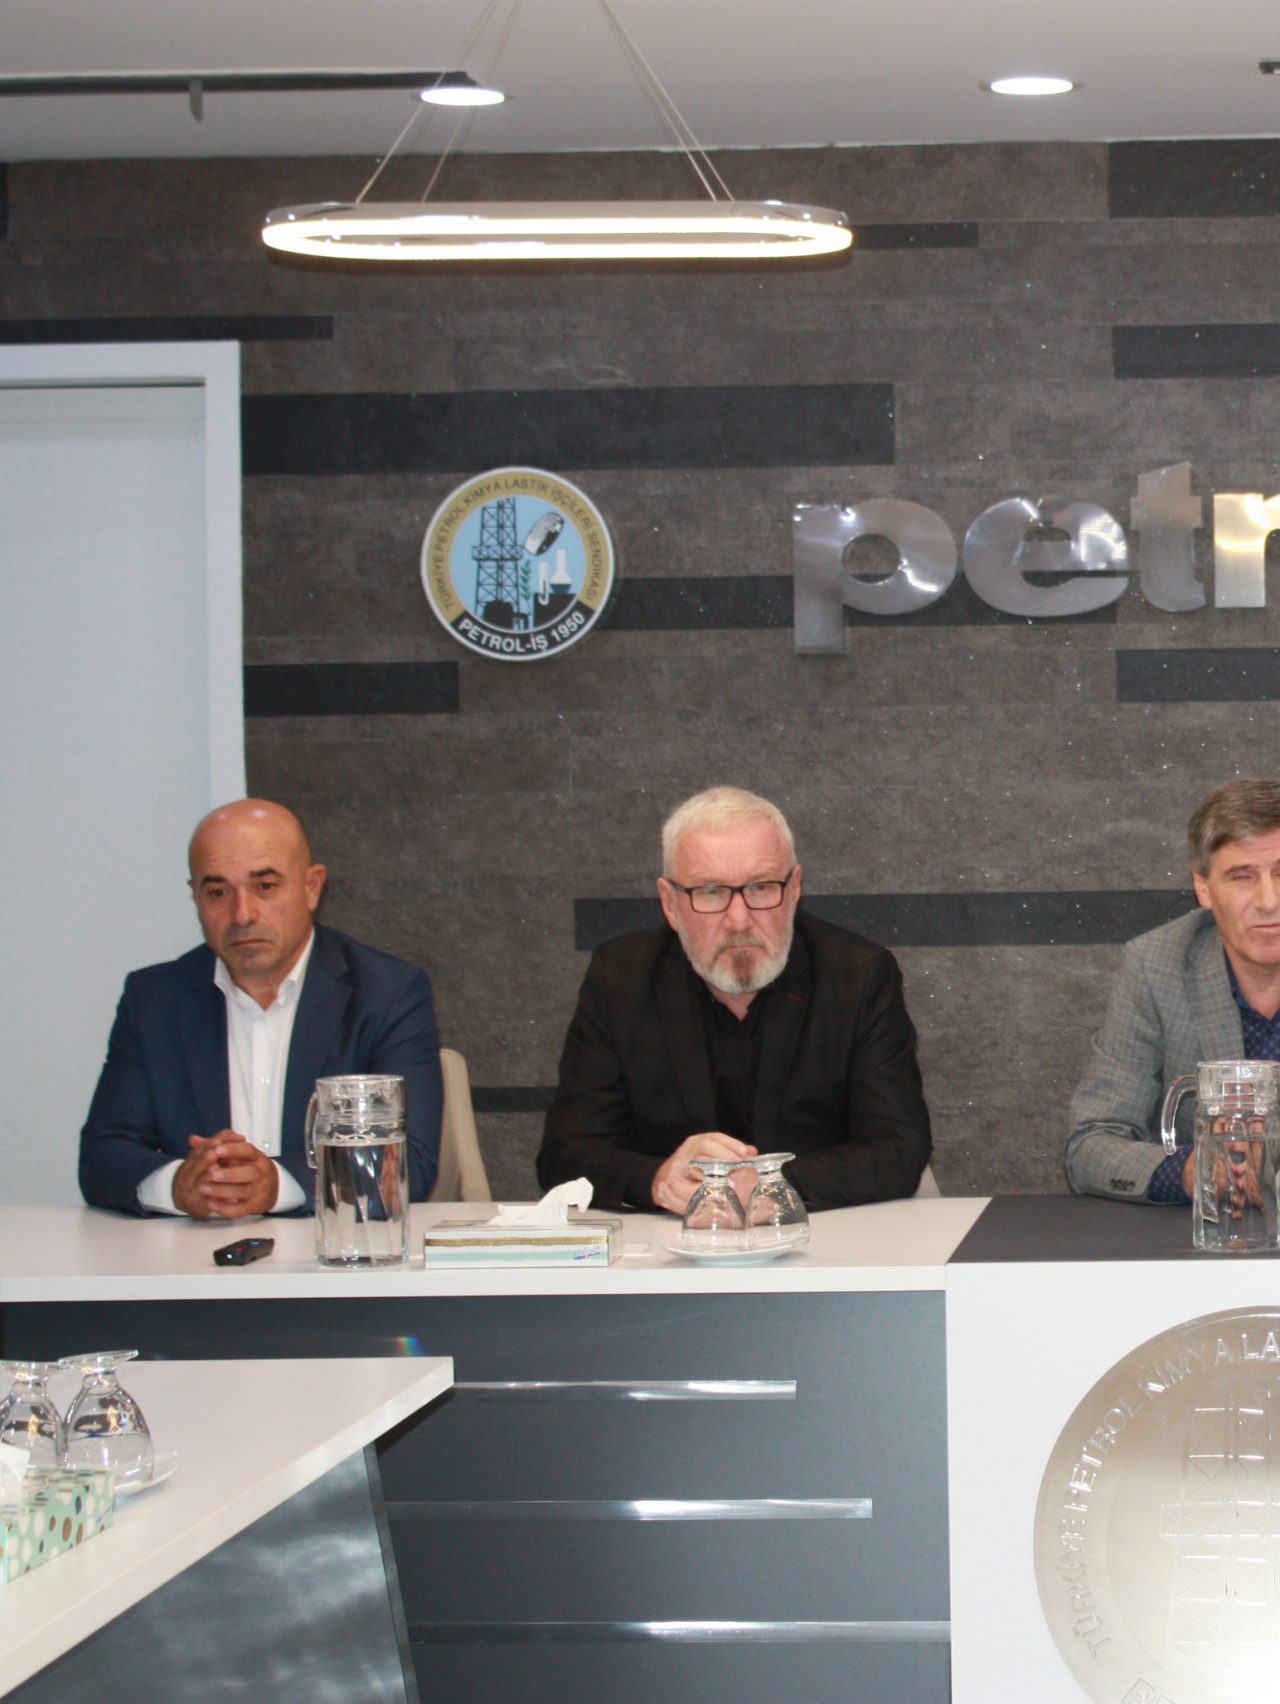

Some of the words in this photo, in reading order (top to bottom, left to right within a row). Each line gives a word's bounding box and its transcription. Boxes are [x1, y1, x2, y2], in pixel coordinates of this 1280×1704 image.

[434, 506, 465, 552] PETROL
[459, 618, 549, 653] PETROL-İŞ
[550, 611, 586, 642] 1950
